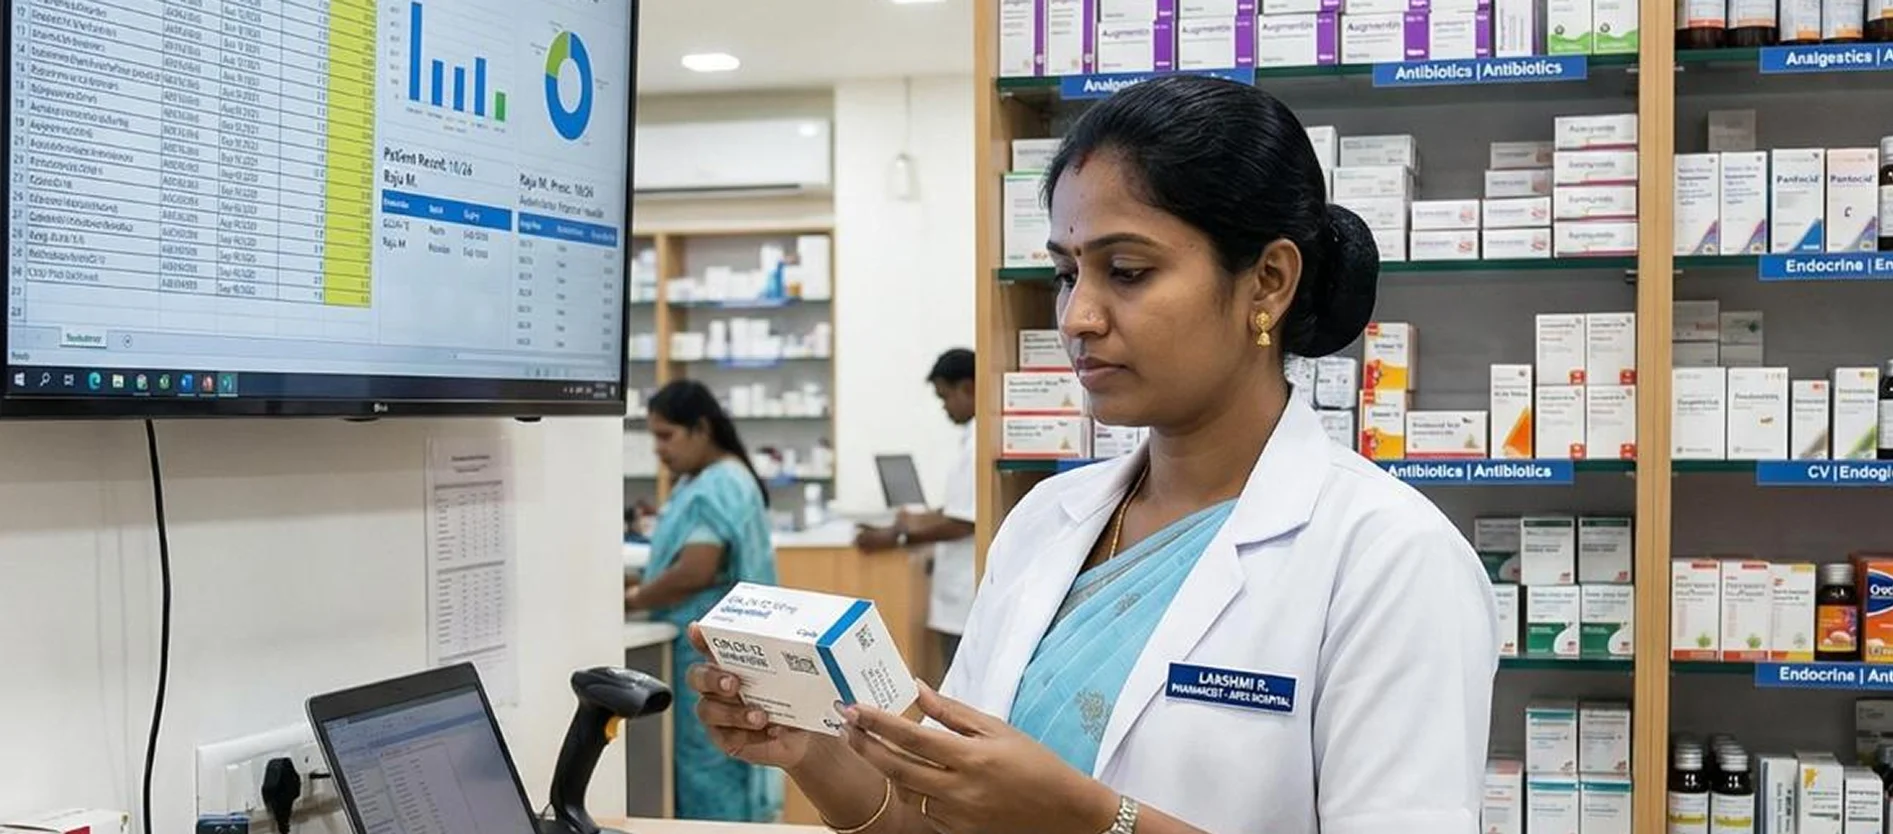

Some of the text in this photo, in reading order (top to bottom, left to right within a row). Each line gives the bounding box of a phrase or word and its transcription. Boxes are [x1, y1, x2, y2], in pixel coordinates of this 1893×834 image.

[1395, 64, 1472, 80] Antibiotics
[1483, 61, 1563, 77] Antibiotics
[1786, 258, 1863, 273] Endocrine
[1389, 465, 1463, 478] Antibiotics
[1474, 464, 1552, 478] Antibiotics
[1808, 465, 1830, 478] CV
[1840, 464, 1893, 482] Endogl
[1779, 666, 1855, 681] Endocrine
[1257, 679, 1270, 692] R.
